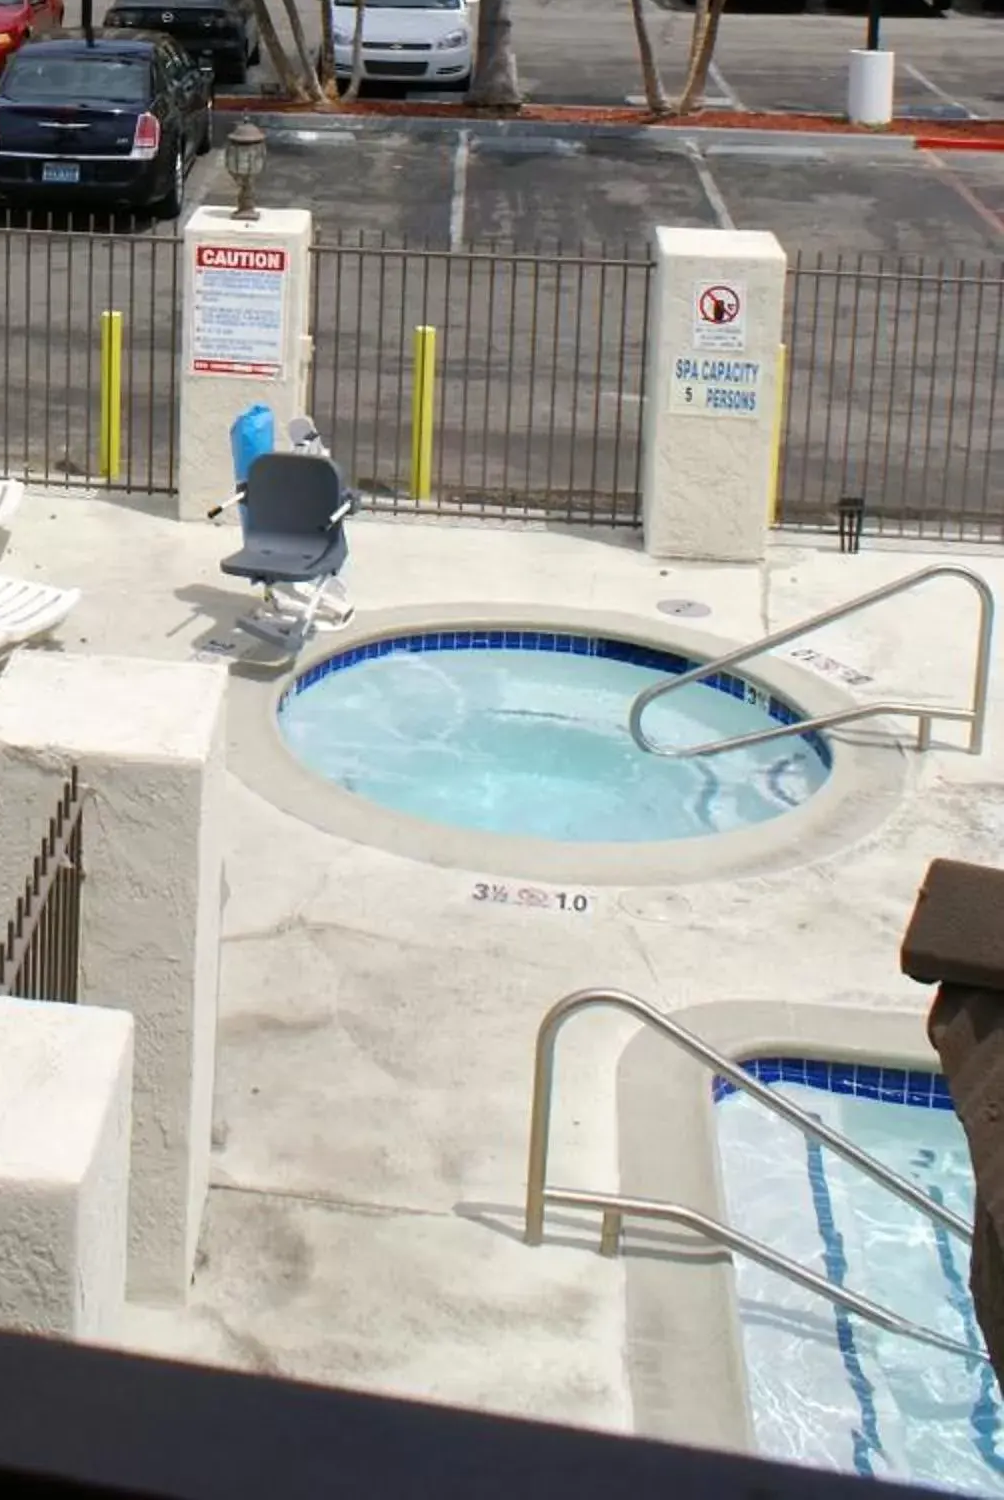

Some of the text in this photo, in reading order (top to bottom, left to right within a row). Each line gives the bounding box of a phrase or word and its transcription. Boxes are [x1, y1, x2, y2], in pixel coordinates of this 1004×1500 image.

[202, 249, 280, 268] CAUTION
[675, 359, 760, 383] SPA CAPACITY
[684, 387, 756, 411] 5 PERSONS
